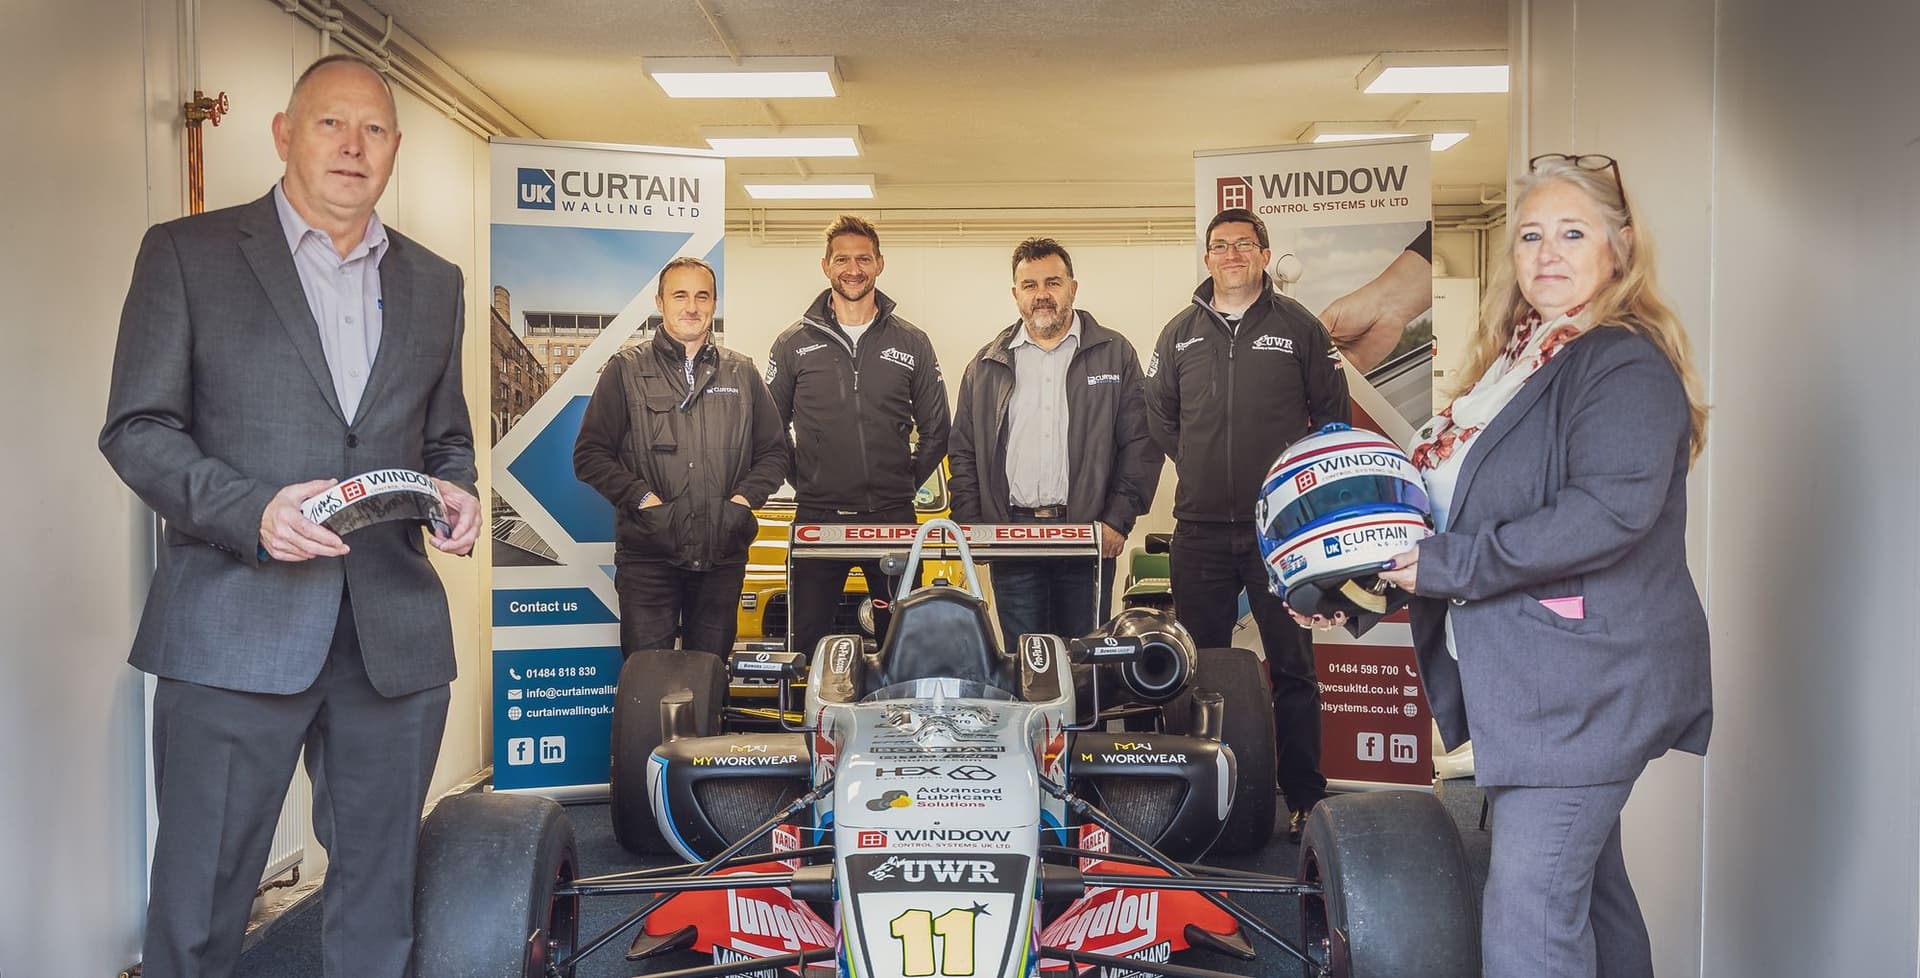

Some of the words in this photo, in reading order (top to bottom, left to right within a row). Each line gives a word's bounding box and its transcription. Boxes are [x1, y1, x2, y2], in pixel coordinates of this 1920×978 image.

[561, 171, 700, 203] CURTAIN
[1259, 165, 1408, 199] WINDOW
[521, 183, 552, 204] UK
[562, 201, 652, 215] WALLING
[668, 207, 700, 218] LTD
[1259, 202, 1309, 214] CONTROL
[1313, 200, 1366, 211] SYSTEMS
[1370, 198, 1386, 208] UK
[1390, 197, 1409, 207] LTD
[1267, 336, 1293, 349] UWR
[1319, 454, 1401, 473] WINDOW
[996, 528, 1092, 539] ECLIPSE
[1343, 526, 1408, 546] CURTAIN
[1325, 544, 1340, 555] UK
[510, 601, 559, 613] Contact
[563, 602, 578, 612] us
[526, 668, 556, 679] 01484
[558, 667, 576, 678] 818
[578, 667, 596, 677] 830
[1328, 664, 1358, 674] 01484
[1360, 664, 1378, 675] 598
[1381, 665, 1399, 676] 700
[543, 741, 562, 760] in
[1394, 739, 1413, 759] in
[1101, 753, 1187, 764] WORKWEAR
[916, 787, 1002, 795] Advanced
[916, 793, 1002, 801] Lubricant
[893, 830, 1011, 842] WINDOW
[903, 859, 999, 884] UWR
[890, 908, 976, 977] 11
